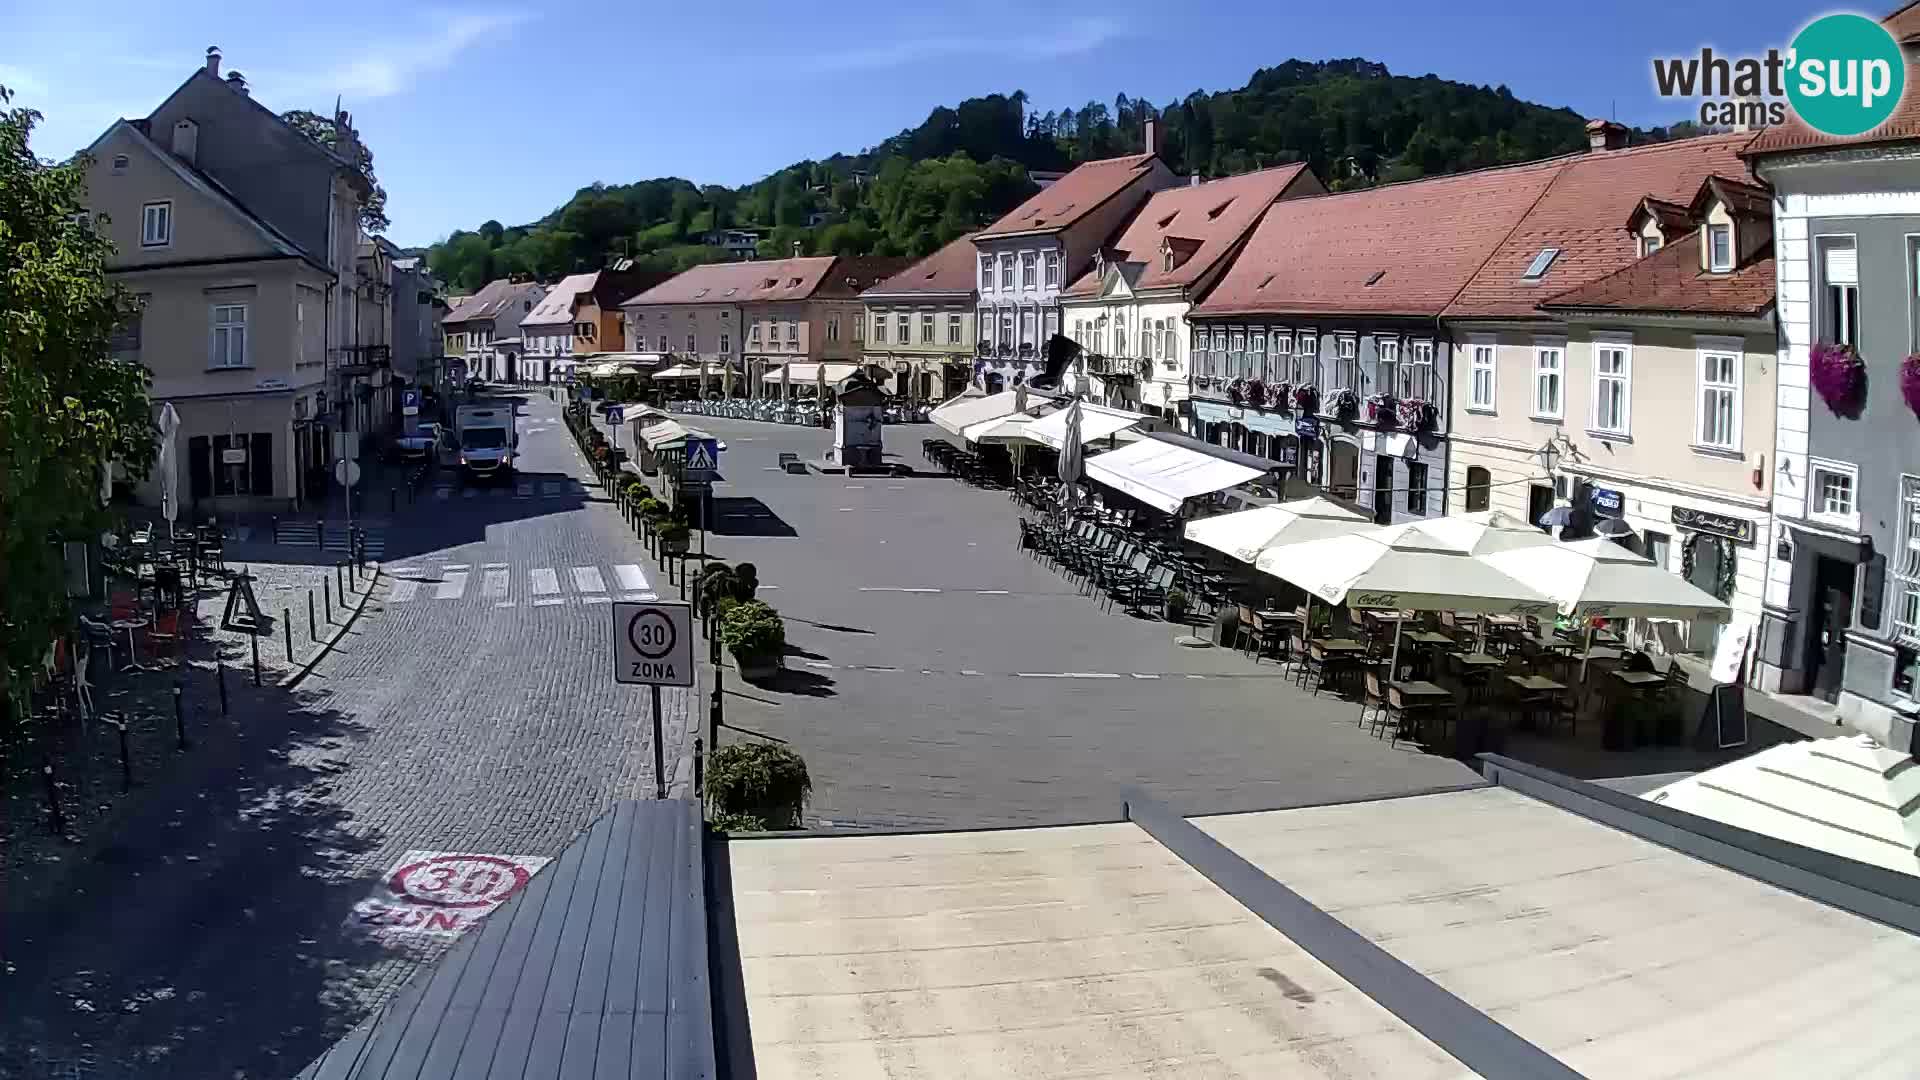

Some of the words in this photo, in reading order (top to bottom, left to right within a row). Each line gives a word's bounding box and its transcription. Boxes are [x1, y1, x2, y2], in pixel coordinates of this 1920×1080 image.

[406, 393, 415, 405] P
[641, 624, 665, 646] 30
[631, 662, 676, 680] ZONA
[417, 867, 500, 895] 30
